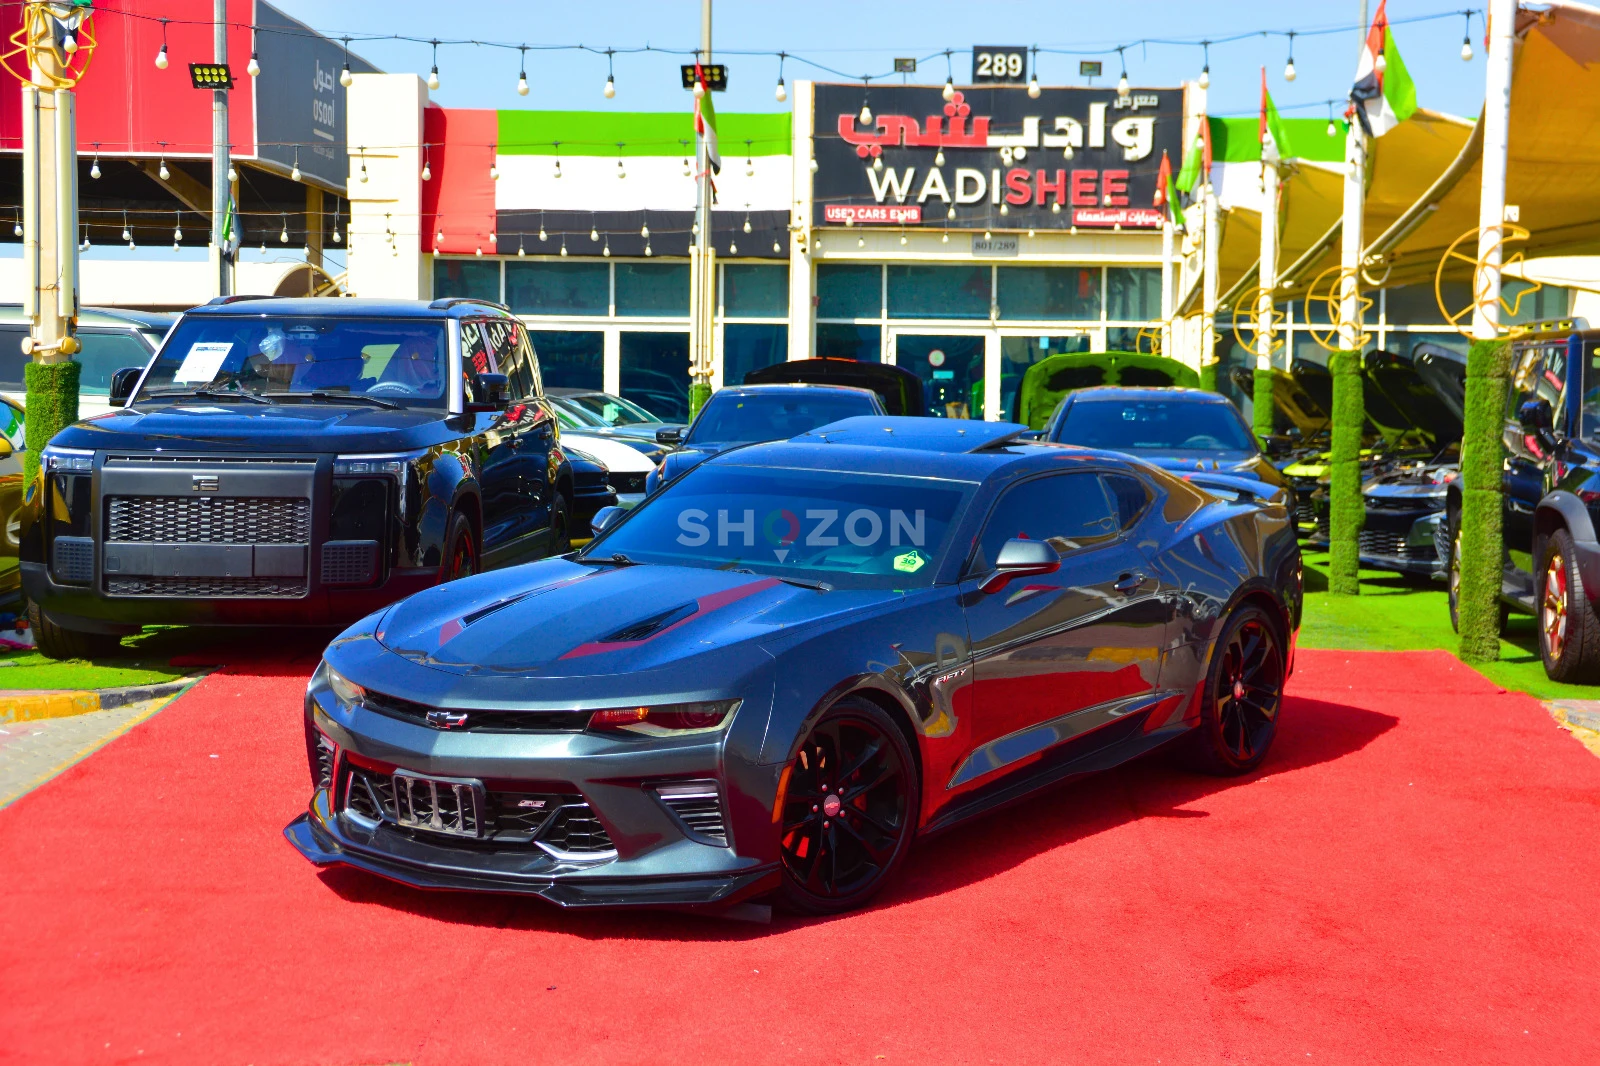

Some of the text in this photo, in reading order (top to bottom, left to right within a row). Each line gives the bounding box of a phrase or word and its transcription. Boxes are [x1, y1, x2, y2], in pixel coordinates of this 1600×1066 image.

[977, 52, 1023, 77] 289
[313, 99, 335, 128] osool
[865, 167, 1130, 206] WADISHEE
[827, 208, 856, 219] USED
[857, 208, 887, 220] CARS
[934, 667, 967, 686] FIFTY
